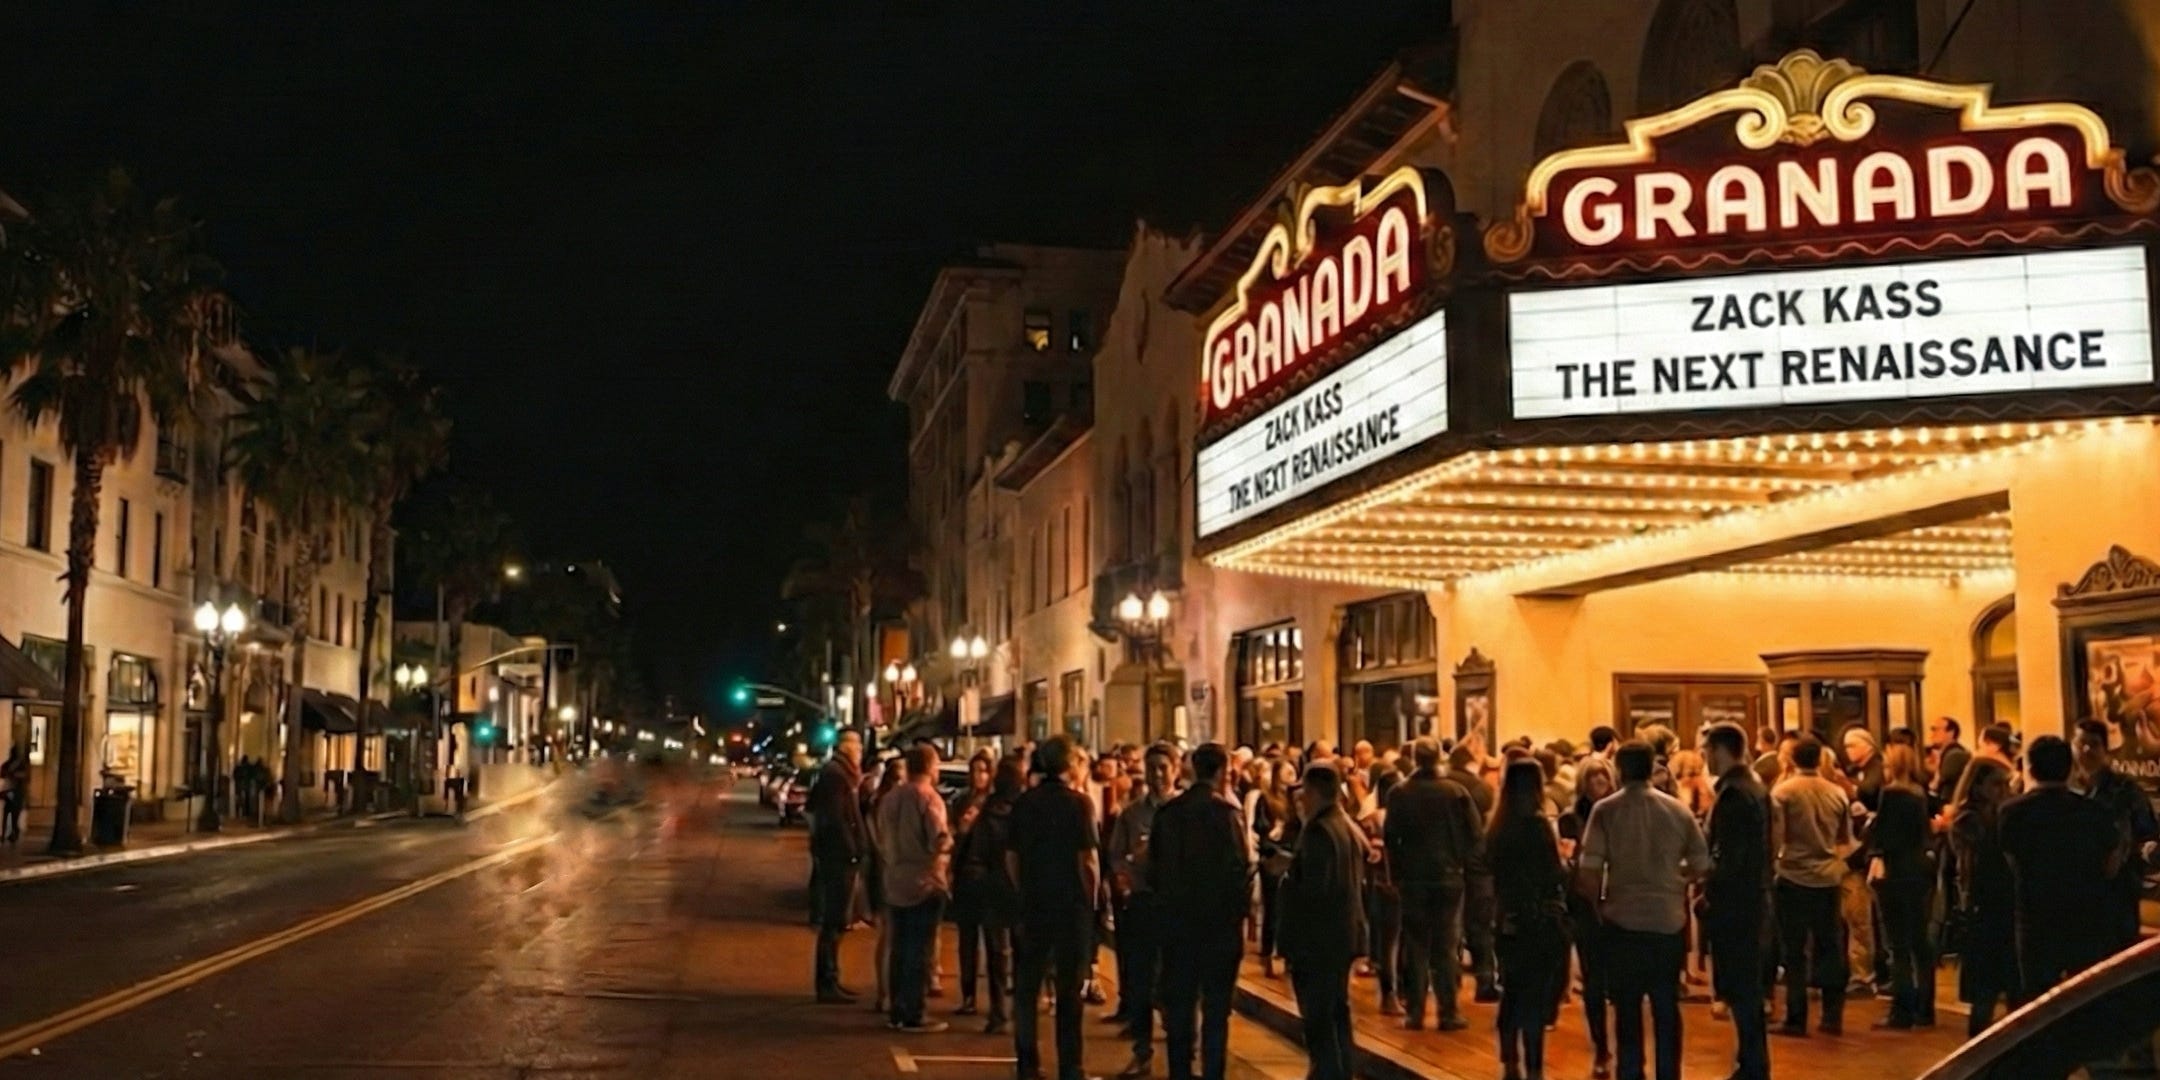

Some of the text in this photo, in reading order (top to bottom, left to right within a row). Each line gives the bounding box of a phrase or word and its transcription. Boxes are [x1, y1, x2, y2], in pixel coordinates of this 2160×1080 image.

[1562, 137, 2072, 246] GRANADA
[1212, 206, 1411, 410] GRANADA
[1690, 279, 1943, 333] ZACK KASS
[1555, 330, 2107, 400] THE NEXT RENAISSANCE
[1228, 404, 1401, 513] THE NEXT RENAISSANCE
[1265, 382, 1343, 451] ZACK KASS
